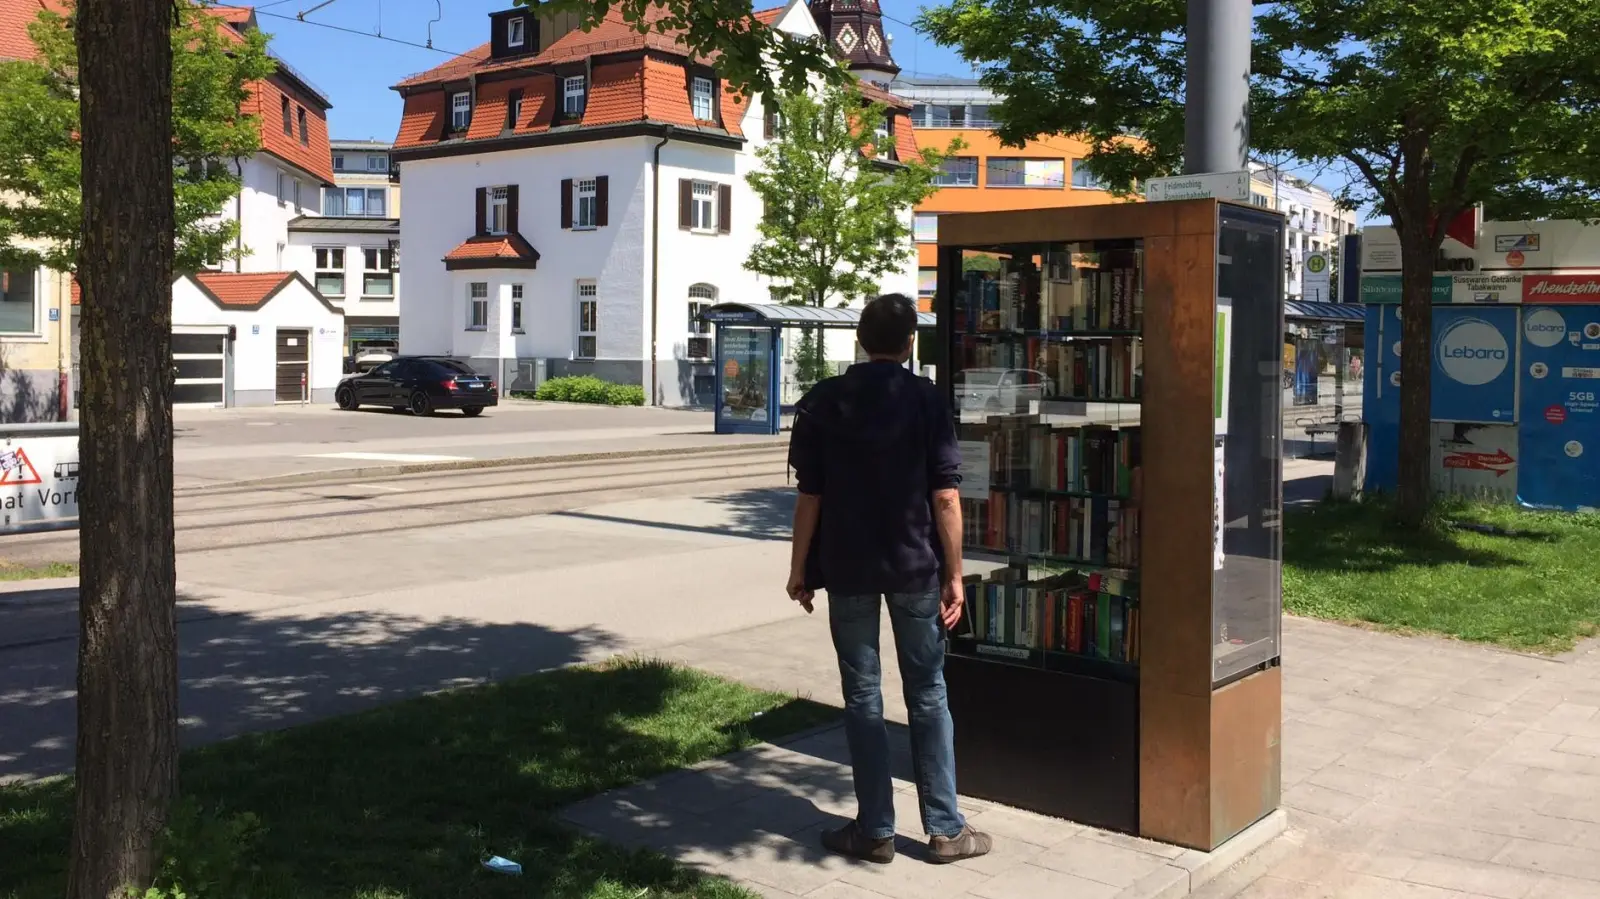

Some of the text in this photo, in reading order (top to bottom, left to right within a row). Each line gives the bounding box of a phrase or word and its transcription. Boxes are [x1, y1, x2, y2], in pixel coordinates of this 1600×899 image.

[1164, 180, 1202, 190] Feldmoching
[1467, 283, 1507, 291] Tabakwaren
[1527, 323, 1565, 333] Lebara
[1444, 345, 1506, 360] Lebara
[1569, 391, 1595, 401] 5GB
